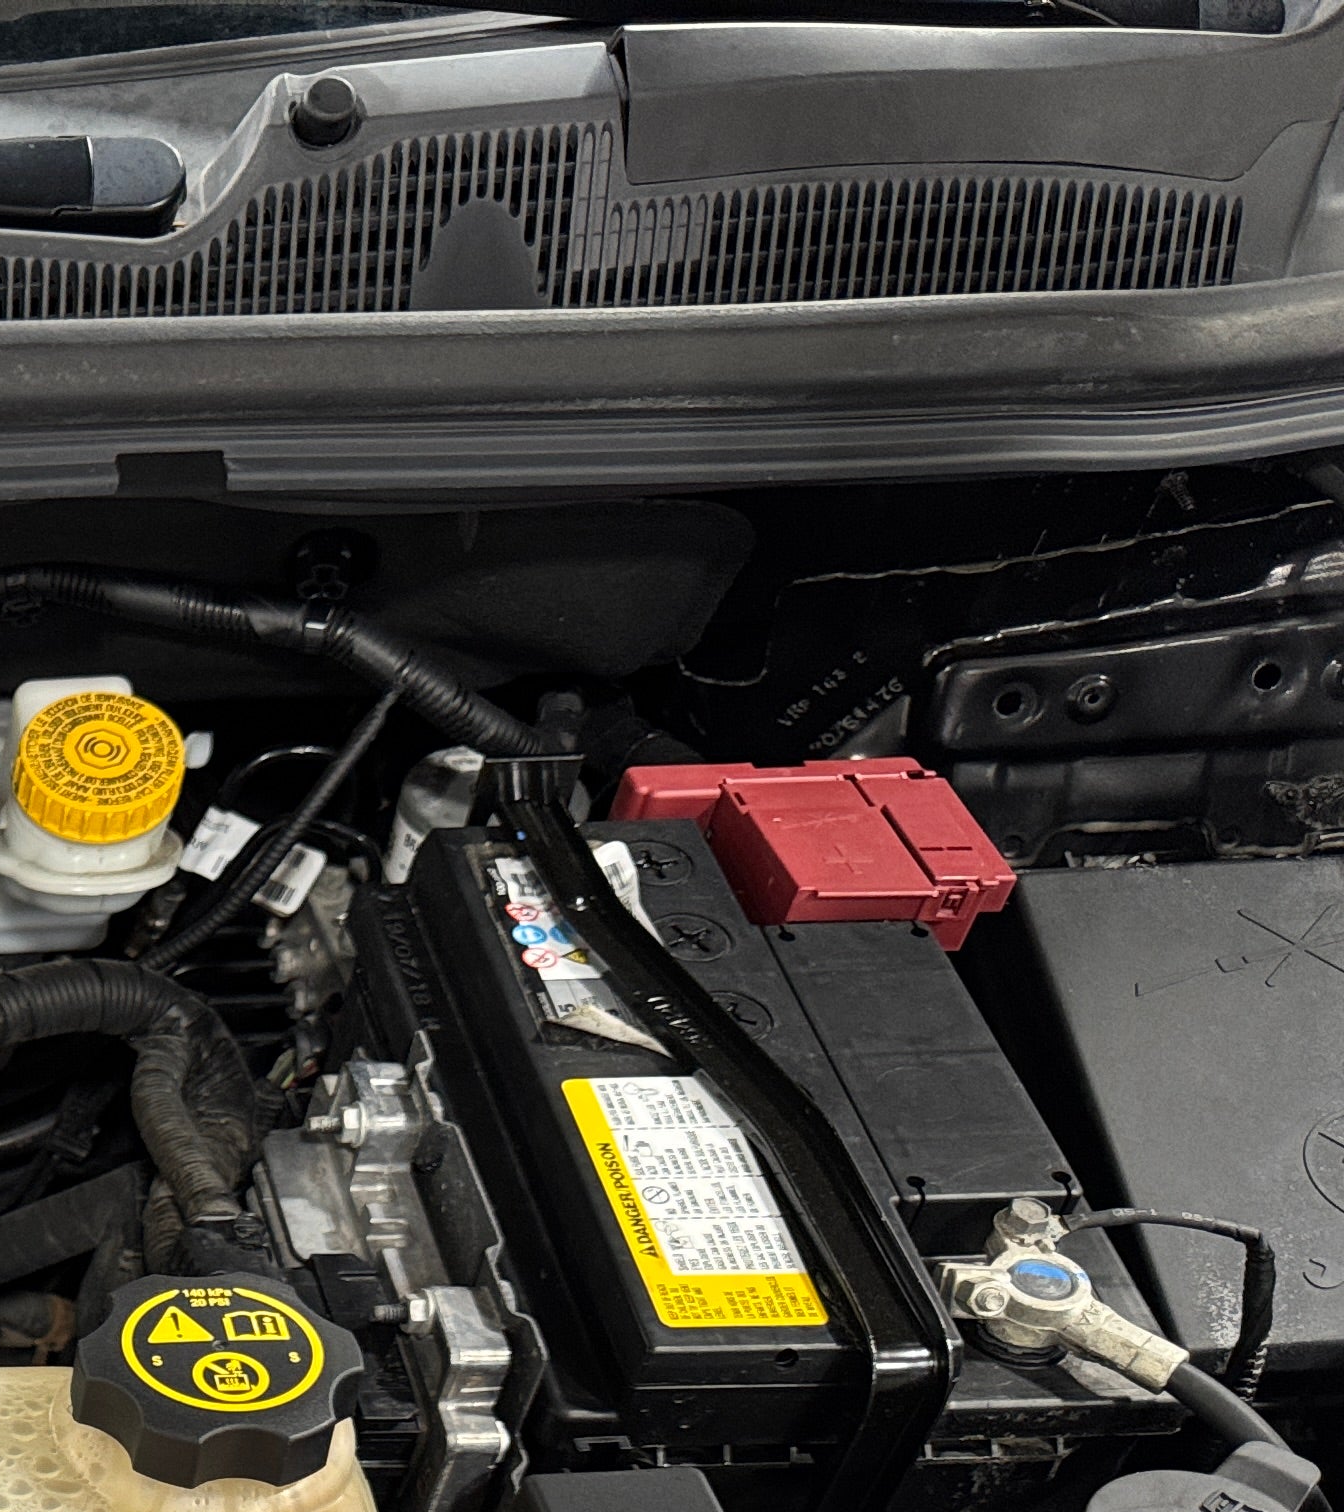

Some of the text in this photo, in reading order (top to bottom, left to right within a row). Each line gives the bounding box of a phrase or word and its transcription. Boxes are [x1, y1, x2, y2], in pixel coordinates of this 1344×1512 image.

[596, 1141, 653, 1247] DANGER/POISON
[182, 1288, 206, 1298] 140
[190, 1298, 231, 1307] 20 PSI
